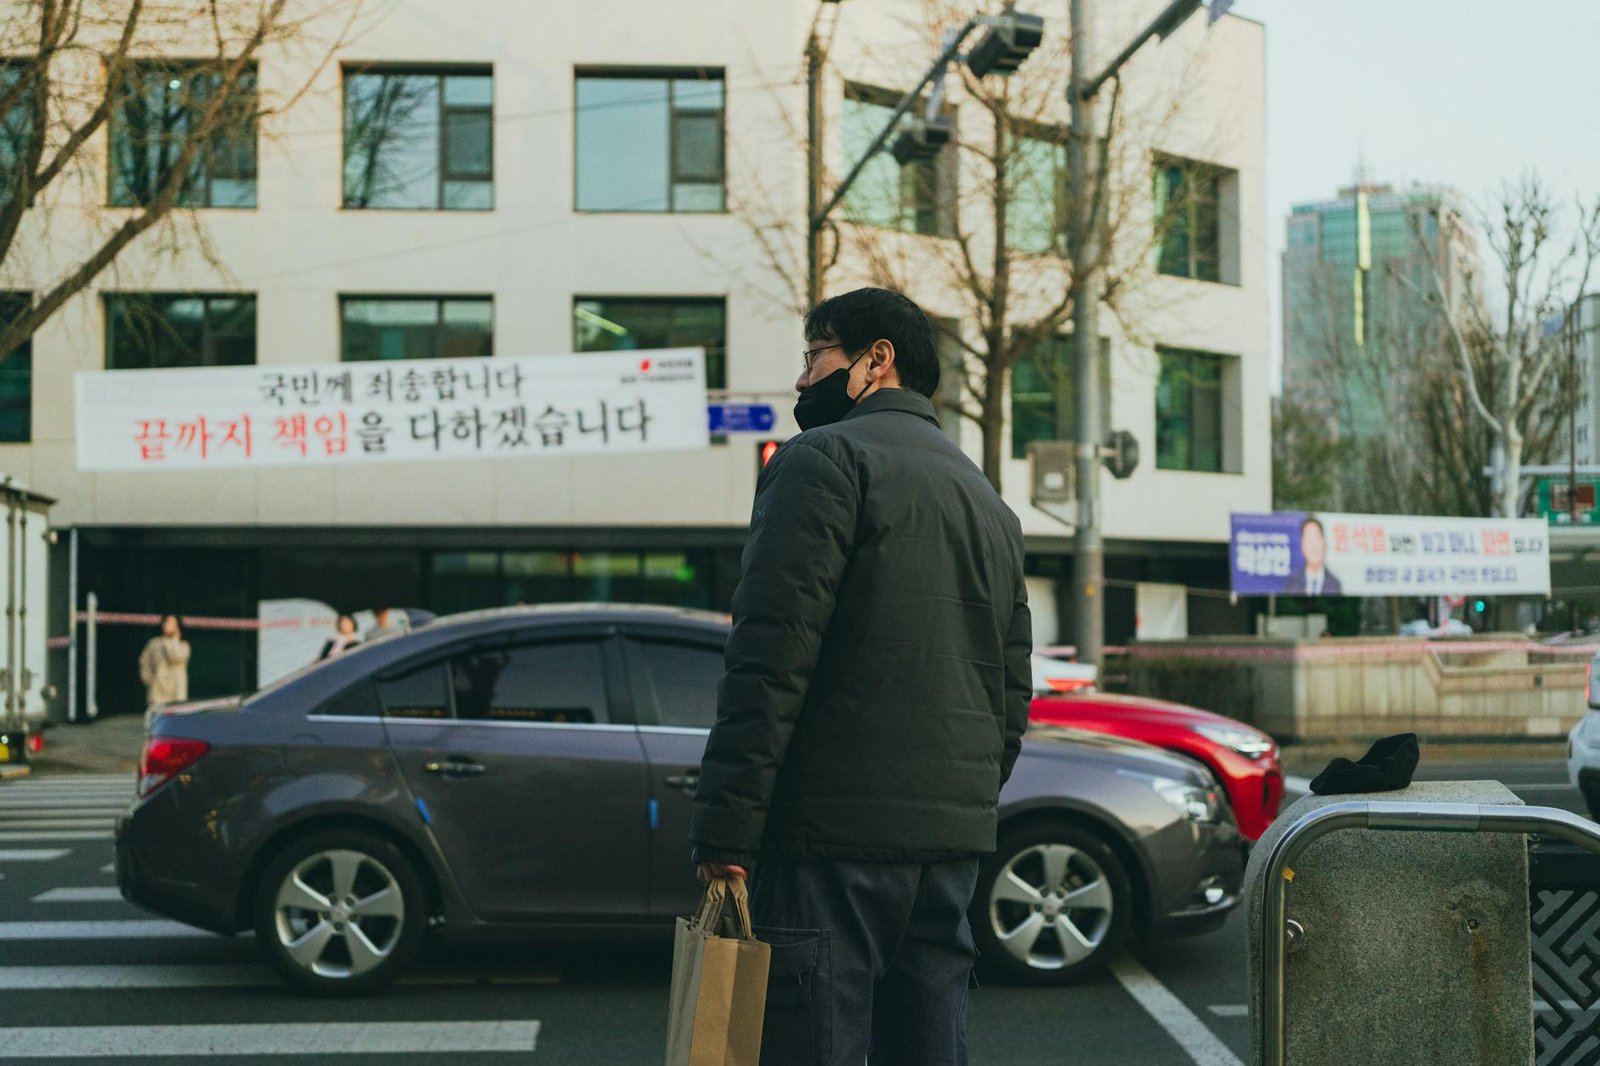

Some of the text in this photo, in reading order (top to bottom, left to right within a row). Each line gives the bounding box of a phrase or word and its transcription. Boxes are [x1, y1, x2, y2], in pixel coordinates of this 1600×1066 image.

[258, 361, 525, 405] 국민께 죄송합니다
[133, 398, 652, 461] 끝까지 책임을 다하겠습니다
